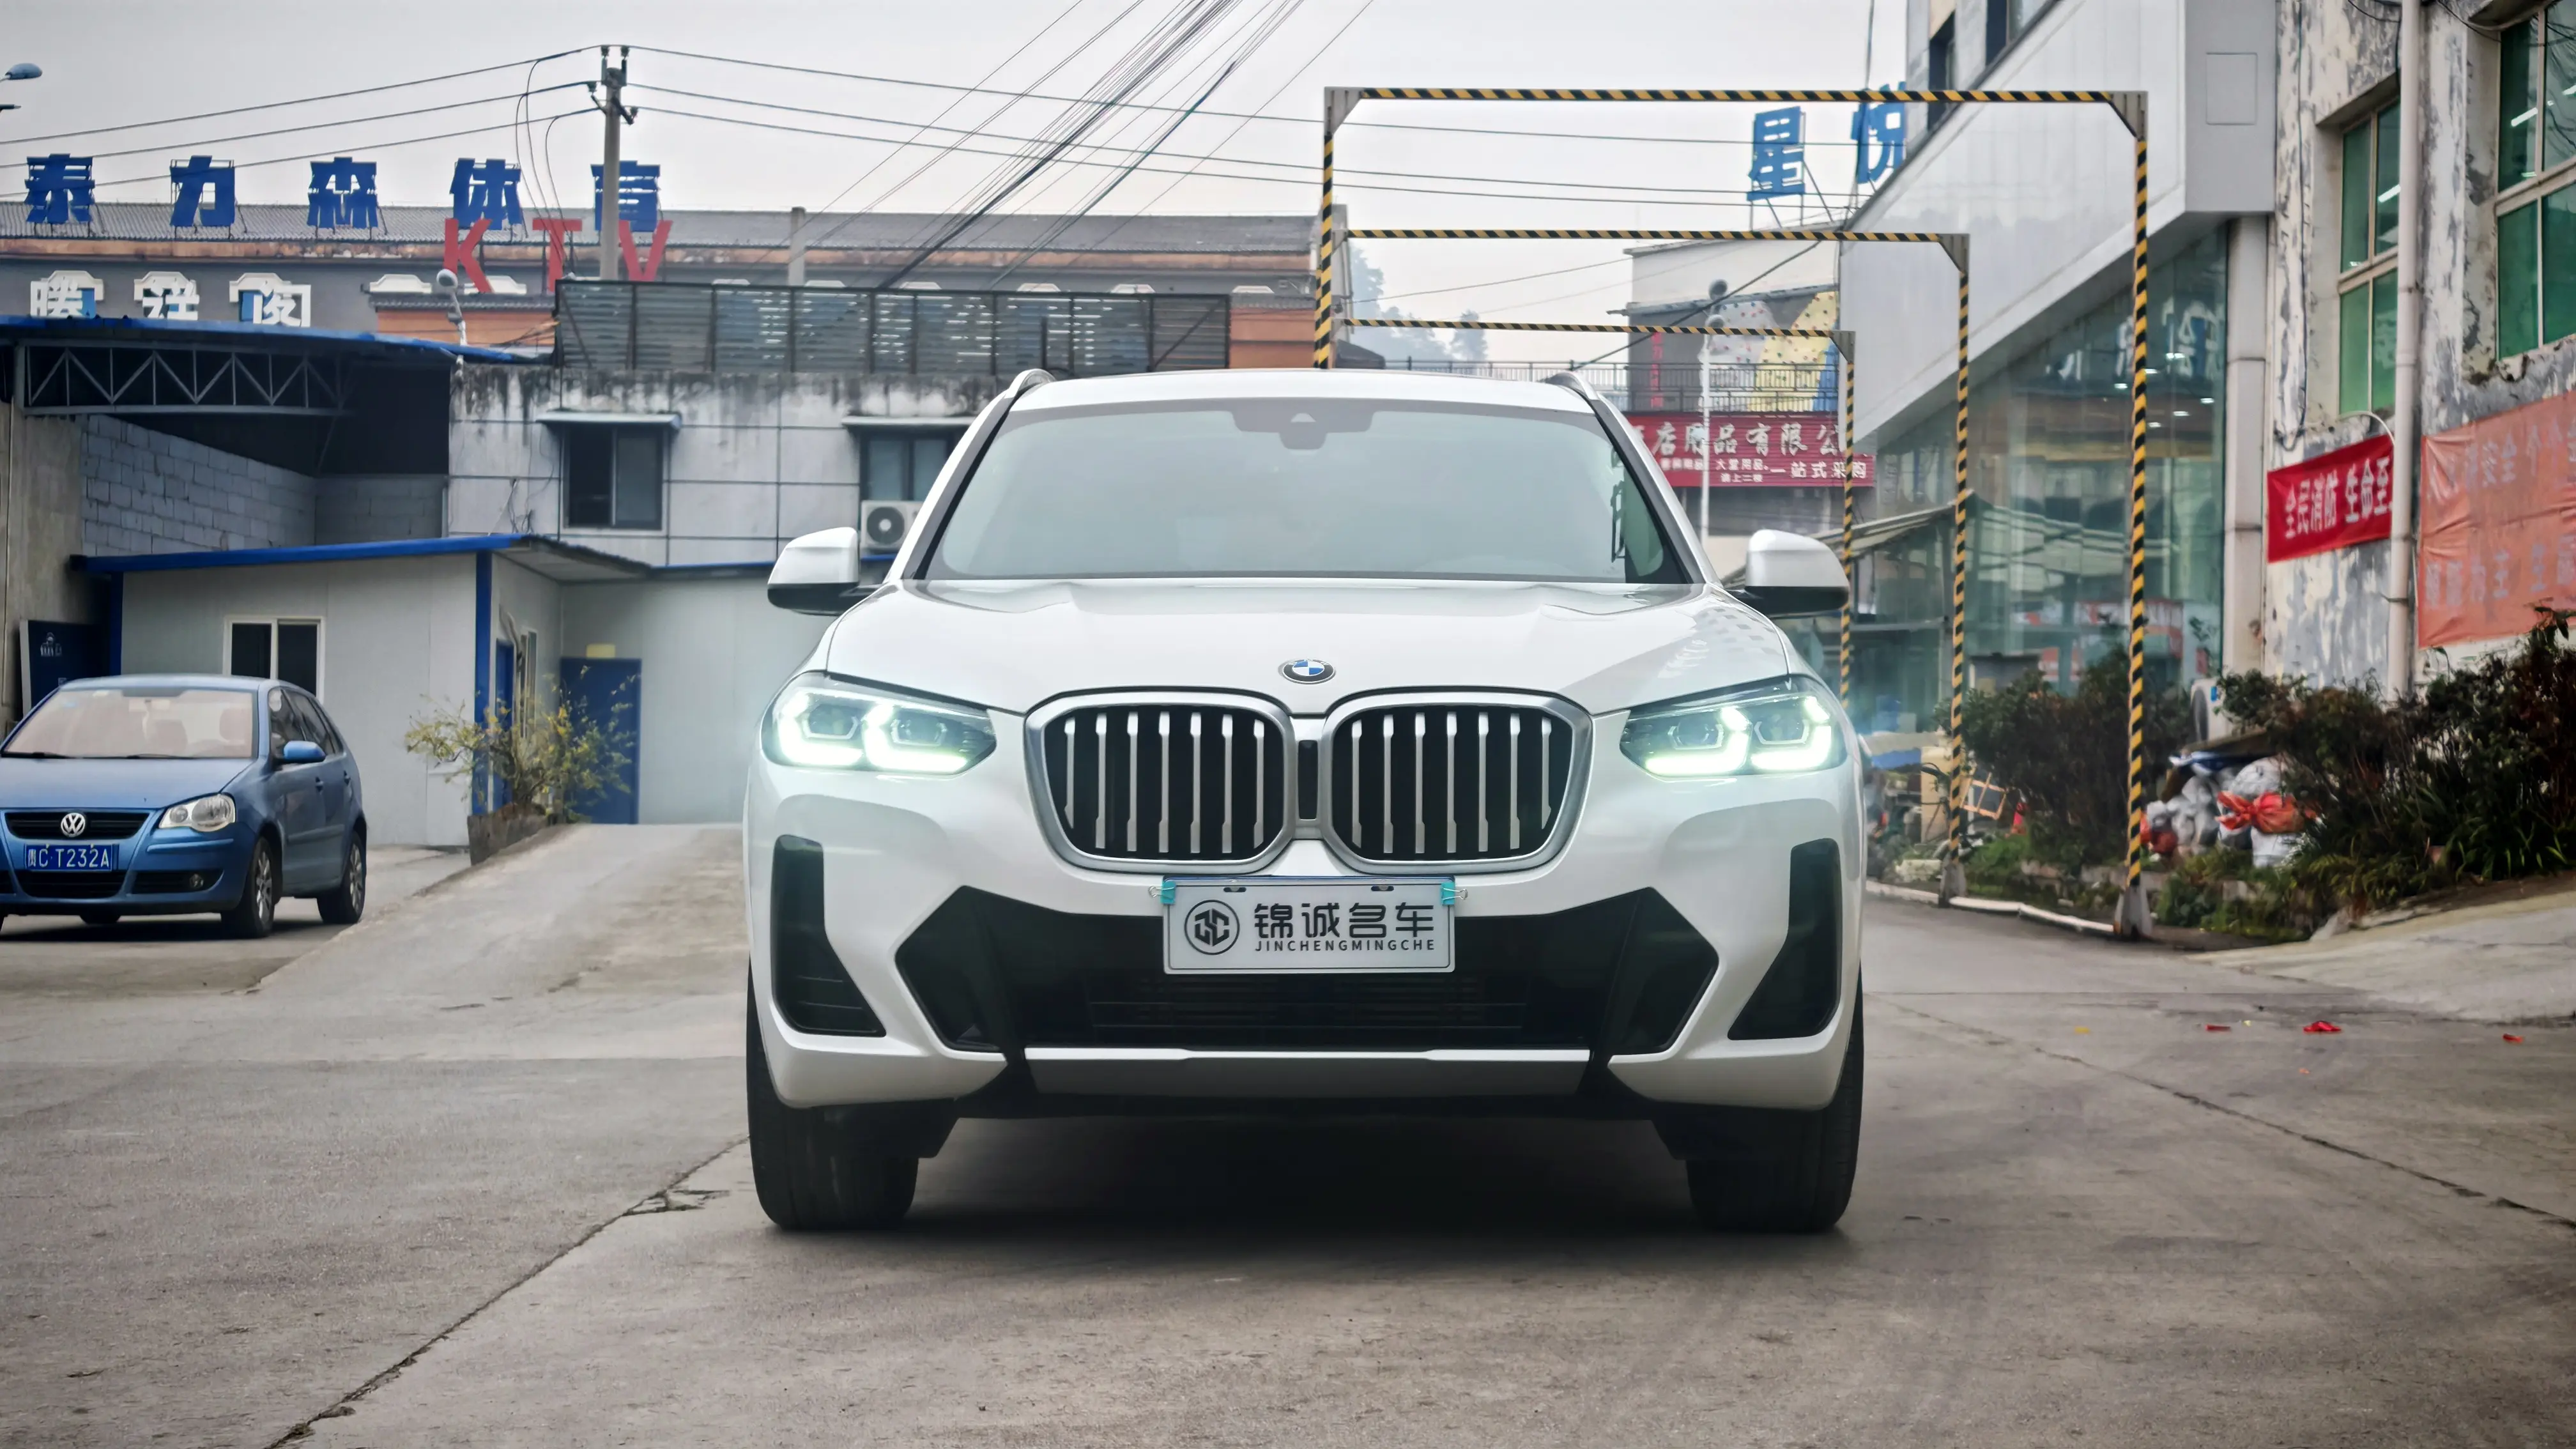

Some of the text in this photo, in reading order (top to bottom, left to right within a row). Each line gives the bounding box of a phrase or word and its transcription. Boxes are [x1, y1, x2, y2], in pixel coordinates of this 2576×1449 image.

[442, 218, 673, 293] KTV
[2345, 455, 2393, 523] 生命至
[1254, 902, 1434, 938] 锦诚名车
[1255, 939, 1435, 951] JINCHENGMINGCHE
